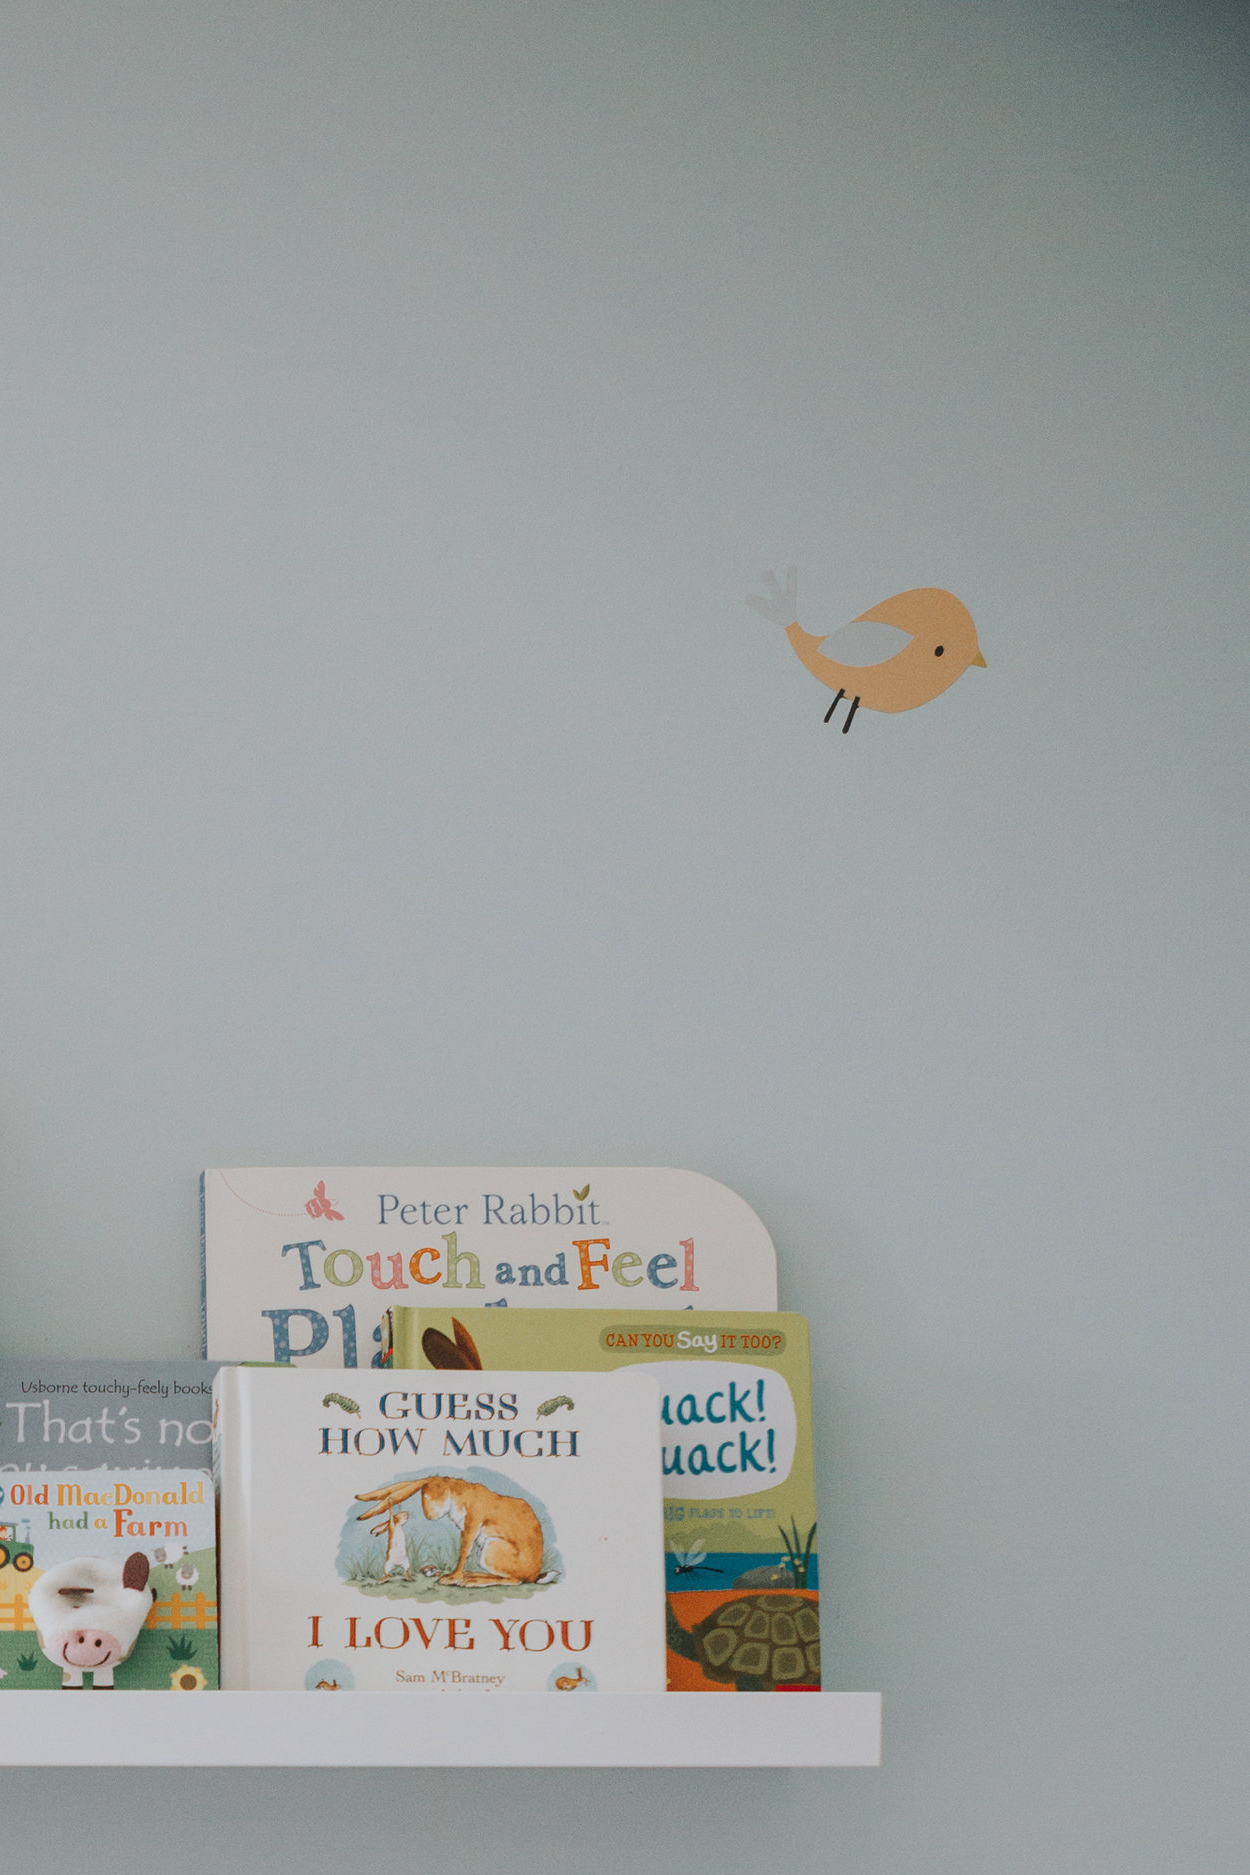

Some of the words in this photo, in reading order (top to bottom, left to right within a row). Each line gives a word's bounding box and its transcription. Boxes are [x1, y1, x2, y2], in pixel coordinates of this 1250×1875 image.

[376, 1194, 469, 1226] Peter
[482, 1190, 602, 1226] Rabbit
[281, 1231, 486, 1291] Touch
[495, 1252, 569, 1287] and
[572, 1237, 700, 1291] Feel
[606, 1333, 638, 1347] CAN
[641, 1333, 674, 1347] YOU
[677, 1330, 718, 1353] Say
[721, 1334, 736, 1348] IT
[741, 1335, 782, 1349] TOO?
[21, 1380, 78, 1394] Usborne
[83, 1379, 169, 1398] touchy-feely
[173, 1381, 213, 1395] books
[379, 1391, 518, 1421] GUESS
[6, 1400, 141, 1444] That's
[319, 1427, 427, 1456] HOW
[443, 1429, 581, 1458] MUCH
[10, 1484, 49, 1506] Old
[56, 1481, 204, 1506] MacDonald
[47, 1511, 88, 1530] had
[94, 1518, 108, 1529] a
[113, 1508, 188, 1537] Farm
[663, 1506, 684, 1521] IG
[307, 1616, 323, 1648] I
[344, 1616, 475, 1650] LOVE
[489, 1618, 595, 1652] YOU
[396, 1670, 425, 1683] Sam
[431, 1670, 505, 1687] McBratney
